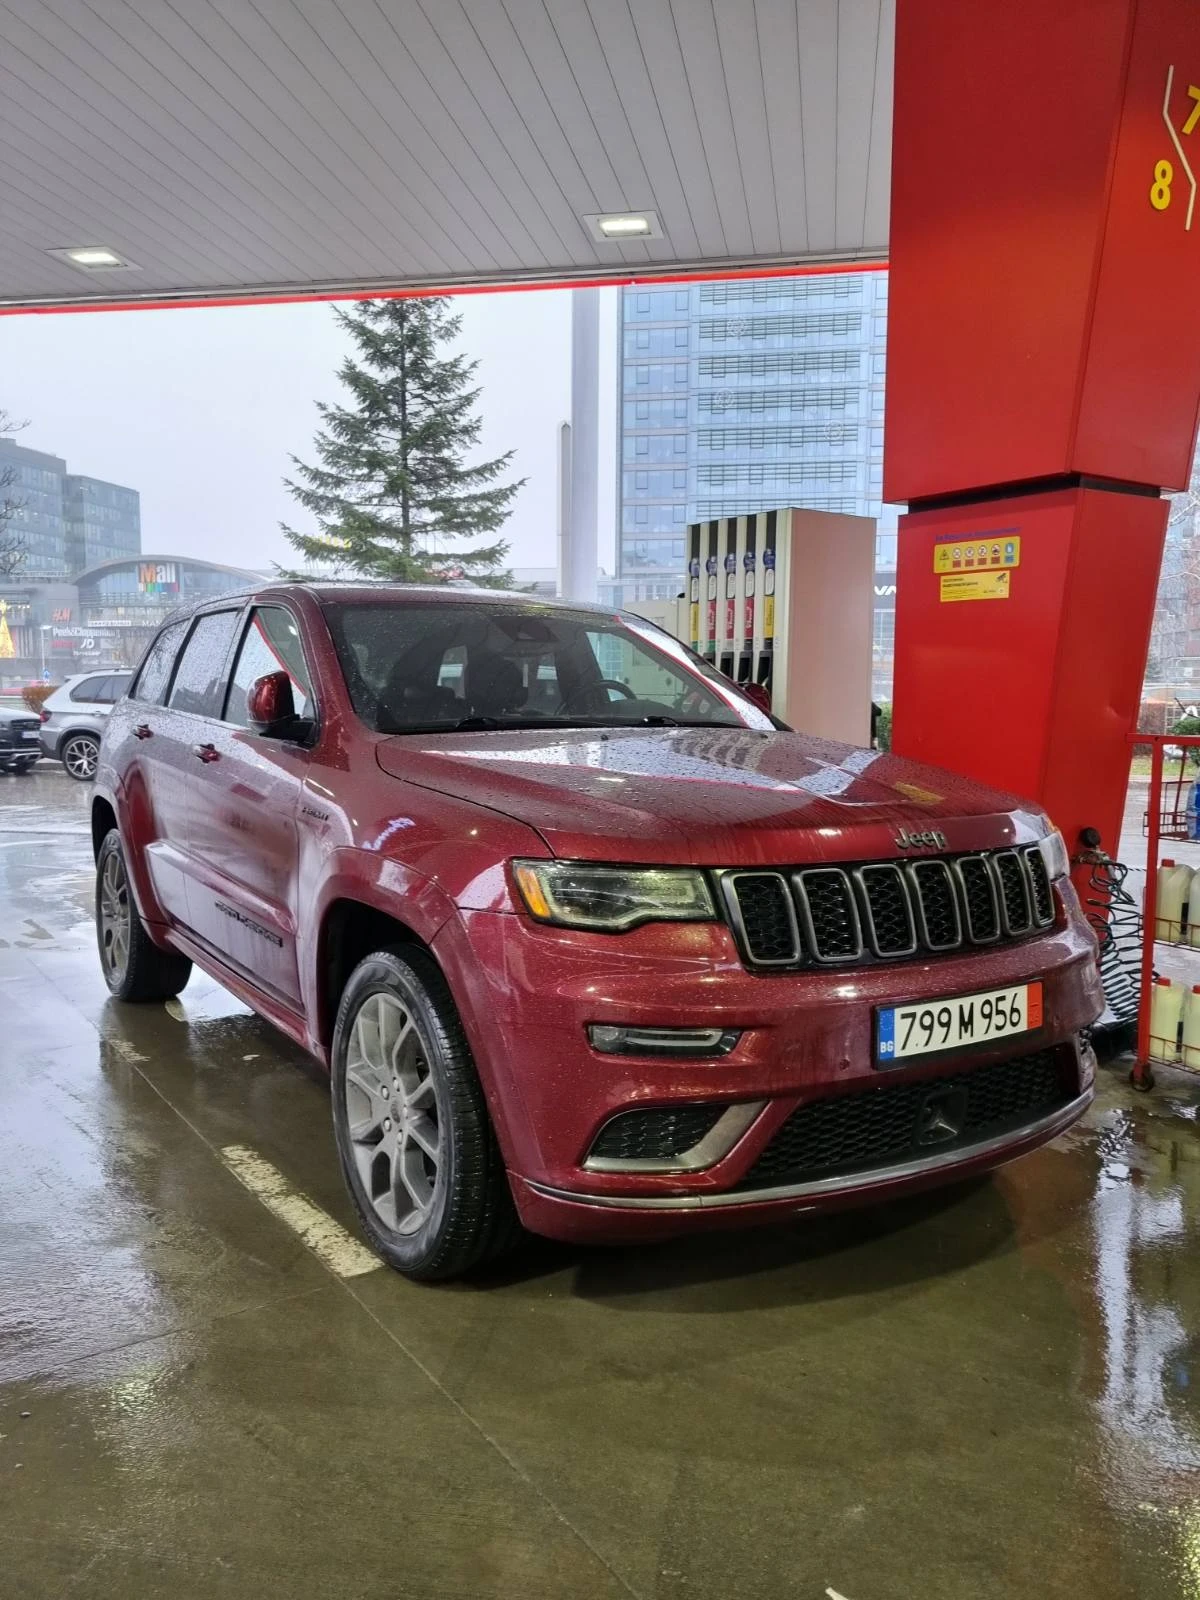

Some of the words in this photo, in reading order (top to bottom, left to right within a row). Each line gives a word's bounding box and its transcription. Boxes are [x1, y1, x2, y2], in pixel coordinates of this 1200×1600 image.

[1150, 159, 1173, 211] 8
[139, 563, 176, 583] Mall
[894, 827, 945, 850] Jeep
[879, 1040, 894, 1053] BG
